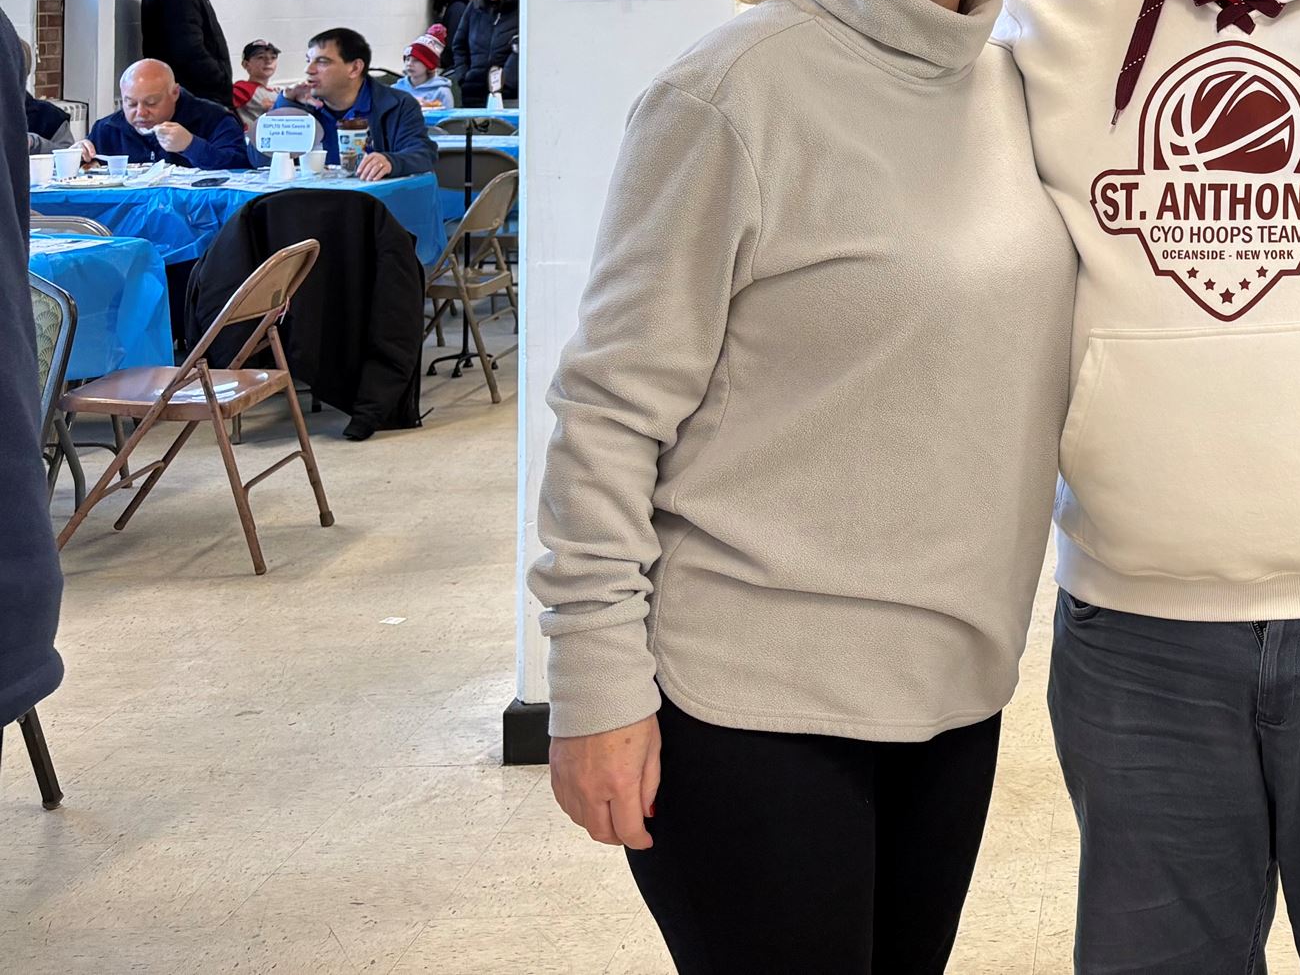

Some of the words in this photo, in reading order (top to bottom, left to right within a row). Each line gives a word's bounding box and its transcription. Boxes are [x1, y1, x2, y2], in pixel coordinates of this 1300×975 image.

[1100, 182, 1147, 222] ST.
[1150, 227, 1184, 243] CYO
[1189, 227, 1253, 243] HOOPS
[1162, 250, 1225, 260] OCEANSIDE
[1236, 250, 1261, 260] NEW
[1263, 249, 1294, 260] YORK
